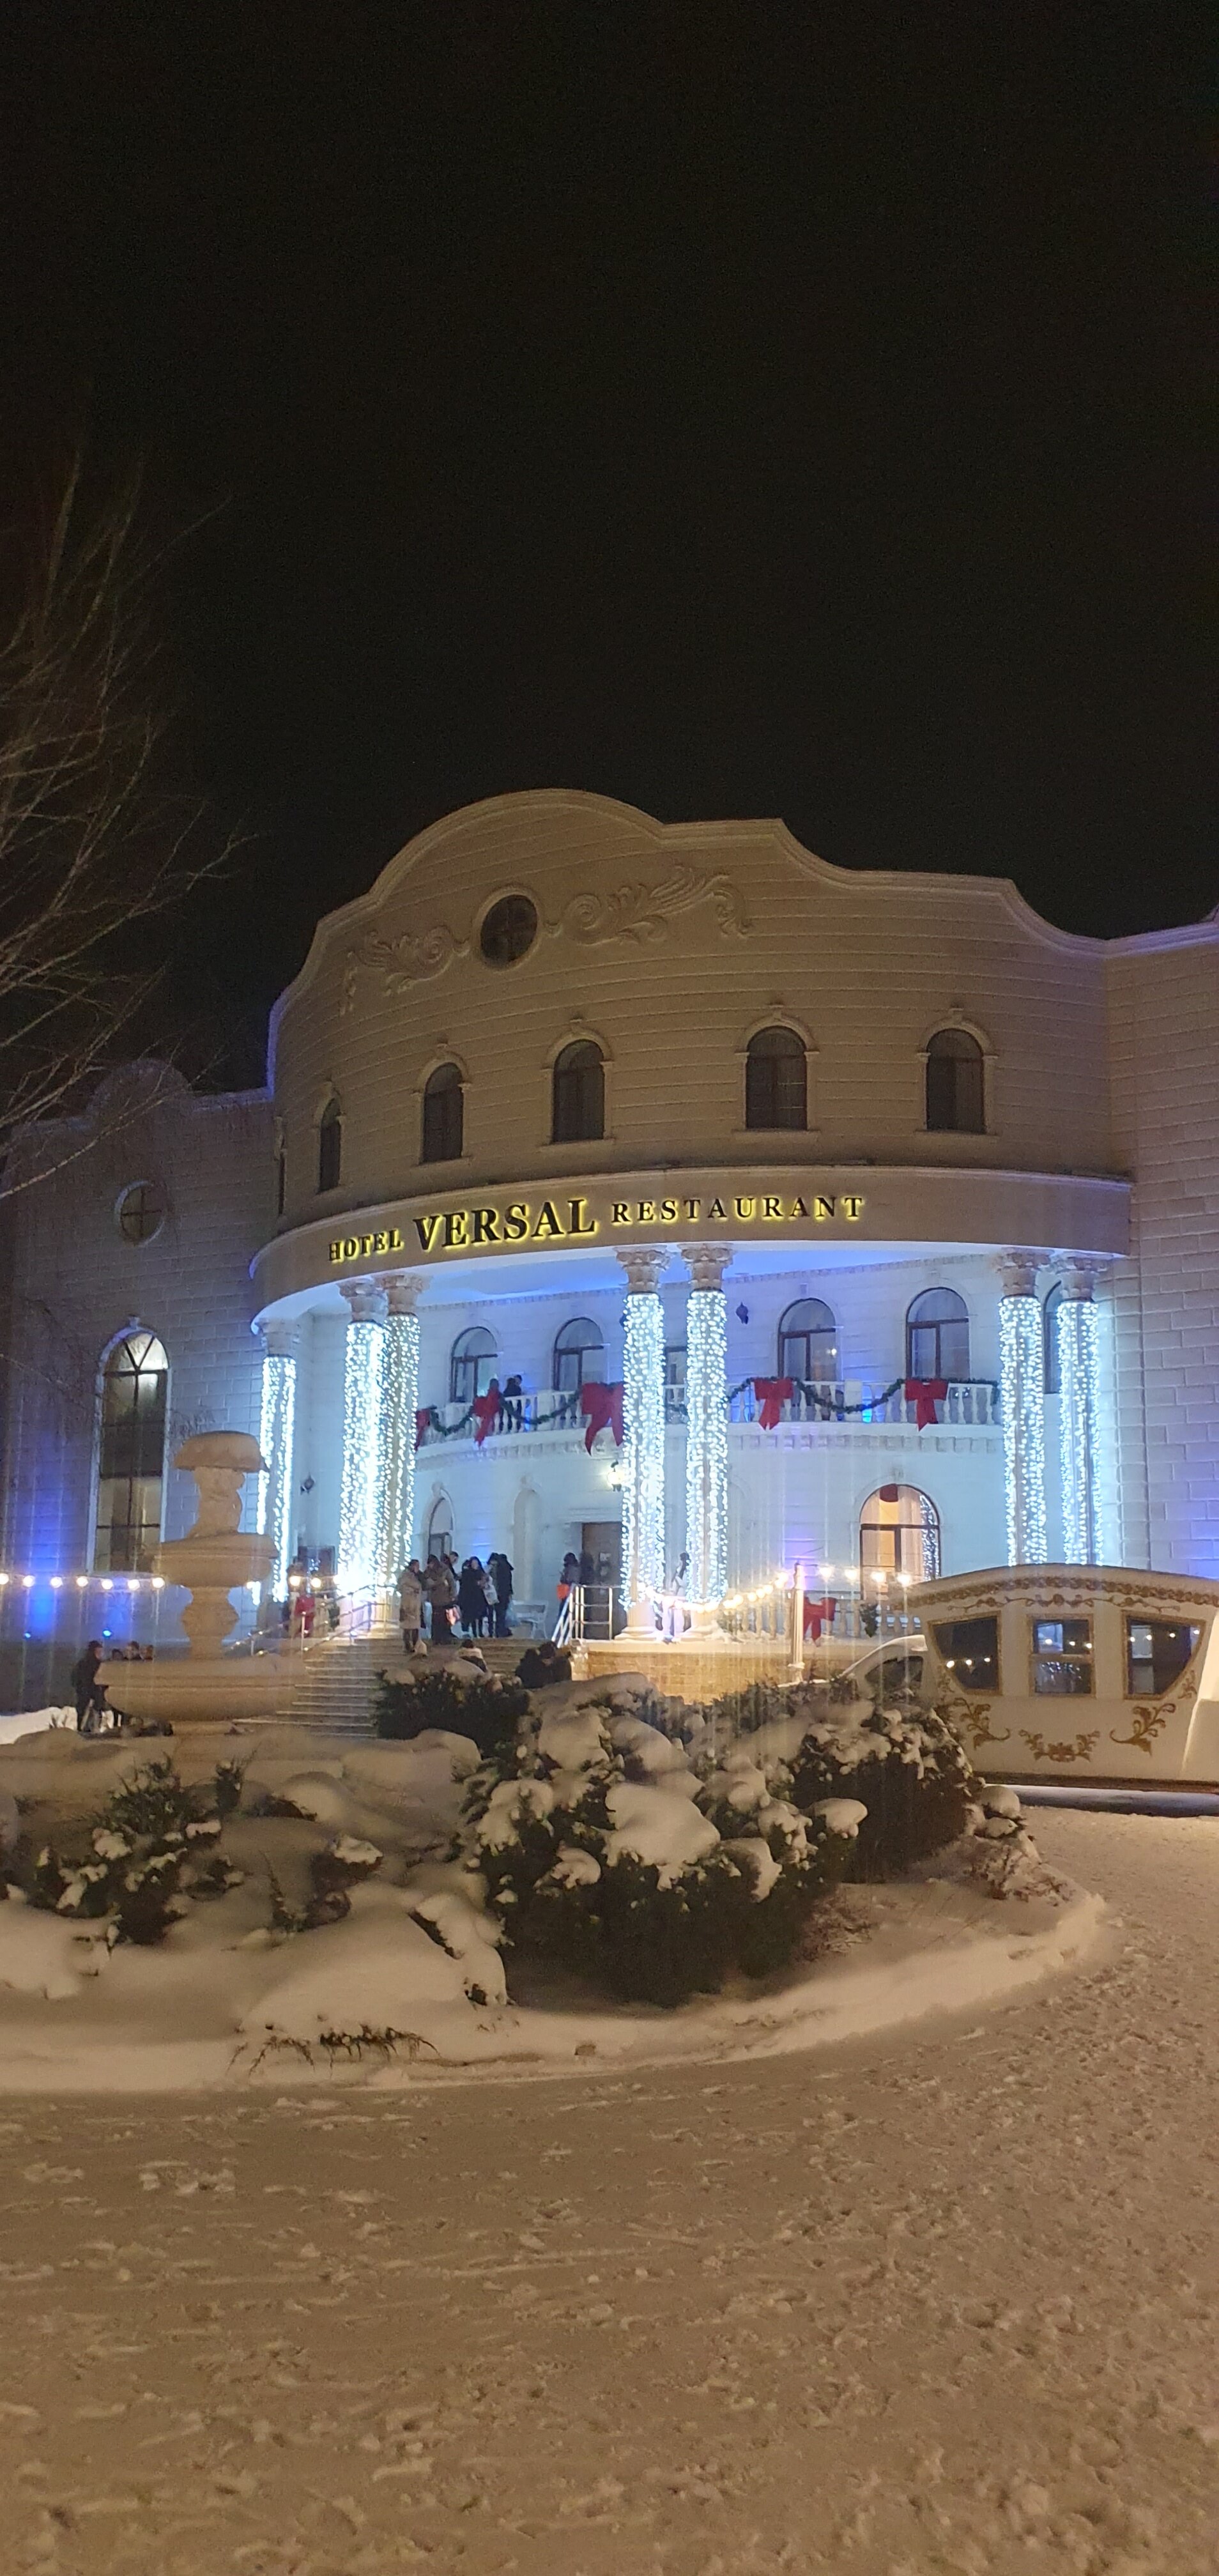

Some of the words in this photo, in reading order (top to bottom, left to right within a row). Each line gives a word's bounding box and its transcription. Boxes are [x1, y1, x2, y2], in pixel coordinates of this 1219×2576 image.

[328, 1229, 404, 1262] HOTEL
[413, 1199, 596, 1251] VERSAL
[611, 1196, 863, 1223] RESTAURANT
